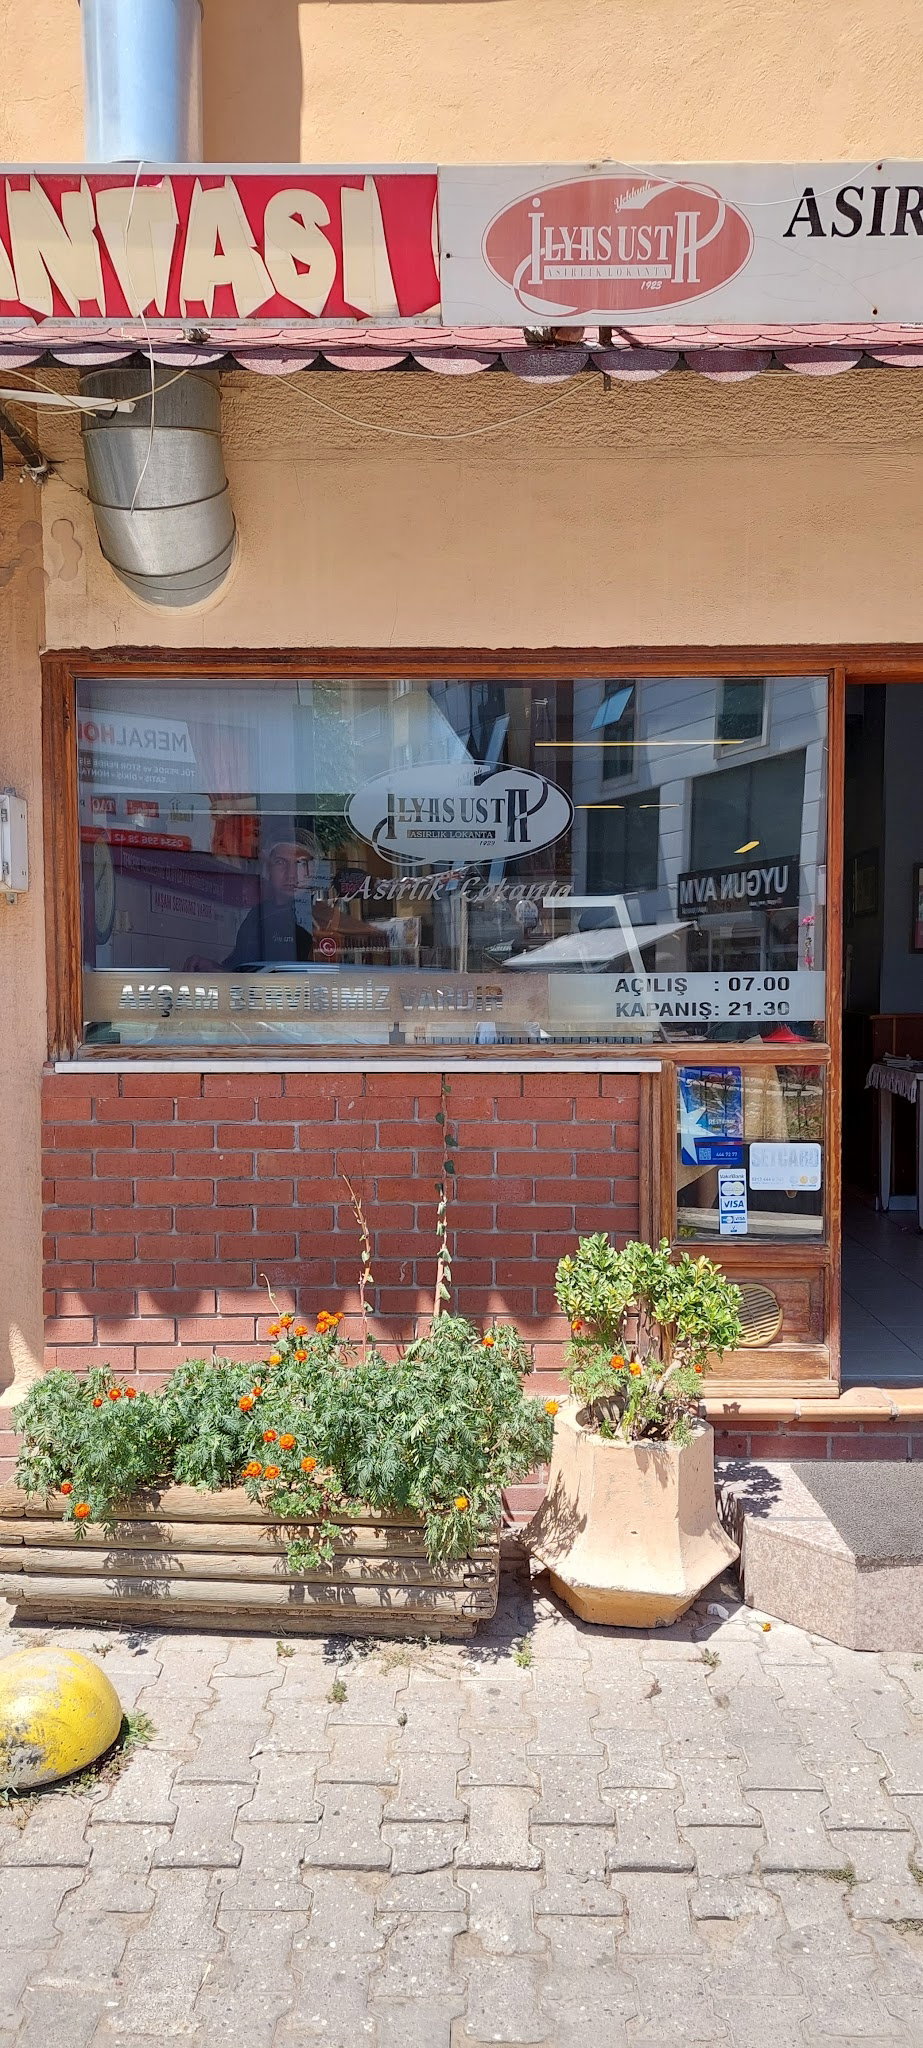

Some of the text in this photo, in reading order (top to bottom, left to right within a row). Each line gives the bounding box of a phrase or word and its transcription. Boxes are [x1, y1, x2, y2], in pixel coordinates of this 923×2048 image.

[782, 186, 923, 238] ASIR
[0, 174, 401, 318] NTASI
[616, 211, 701, 284] USTA
[547, 266, 669, 278] ASIRLIK LOKANTA
[640, 280, 663, 290] 1923
[410, 830, 494, 839] ASIRLIK LOKANTA
[615, 977, 688, 996] AÇILIŞ
[728, 976, 790, 992] 07.00
[118, 979, 503, 1017] AKŞAM SERVİSİMİZ VARDIR
[728, 1001, 790, 1017] 21.30
[724, 1200, 745, 1208] VISA
